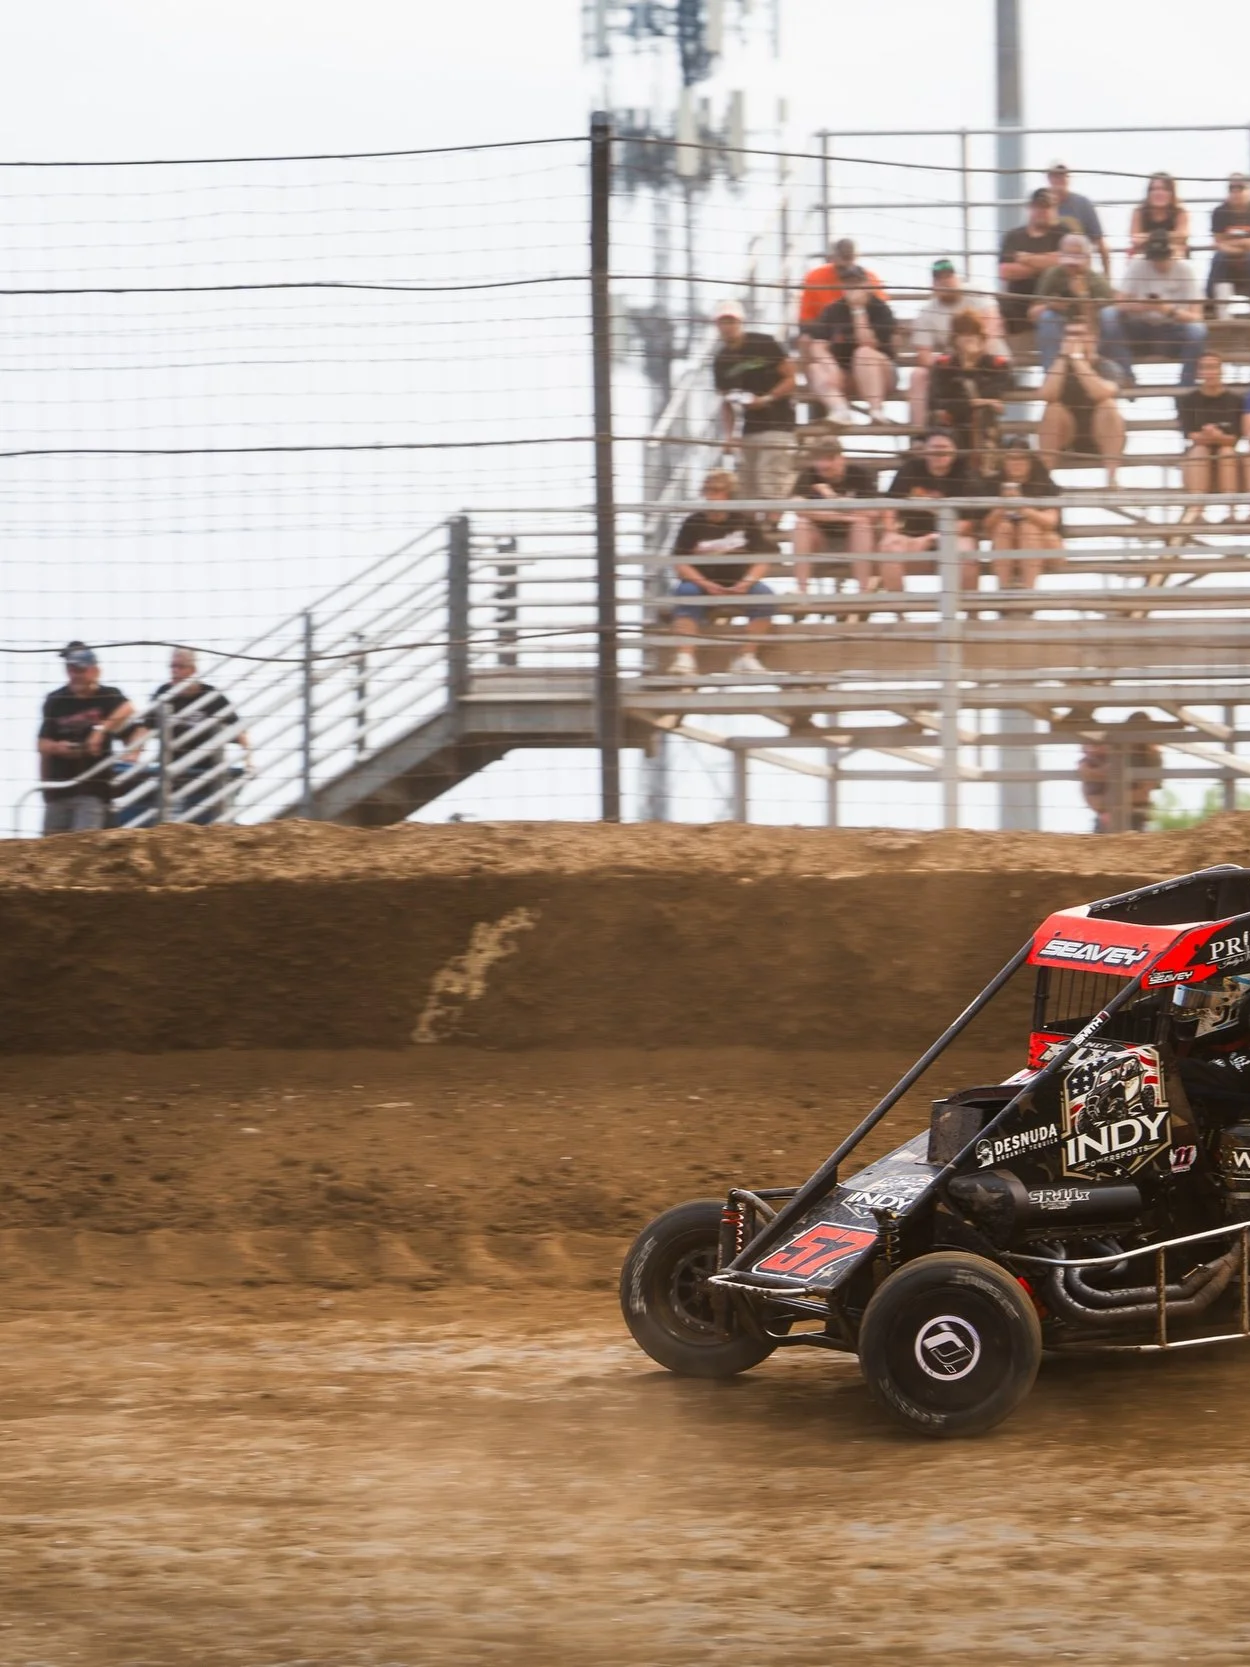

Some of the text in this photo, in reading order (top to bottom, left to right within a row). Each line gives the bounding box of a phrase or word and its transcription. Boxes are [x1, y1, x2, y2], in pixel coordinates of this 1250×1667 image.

[1039, 938, 1149, 966] SEAVEY
[1148, 970, 1194, 985] SEAVEY
[1072, 1018, 1104, 1047] SMITH
[994, 1123, 1057, 1156] DESNUDA
[996, 1137, 1058, 1162] ORGANIC TEQUILA
[1066, 1111, 1169, 1166] INDY
[1084, 1144, 1148, 1168] POWERSPORTS
[846, 1191, 914, 1211] INDY
[760, 1225, 878, 1277] 57
